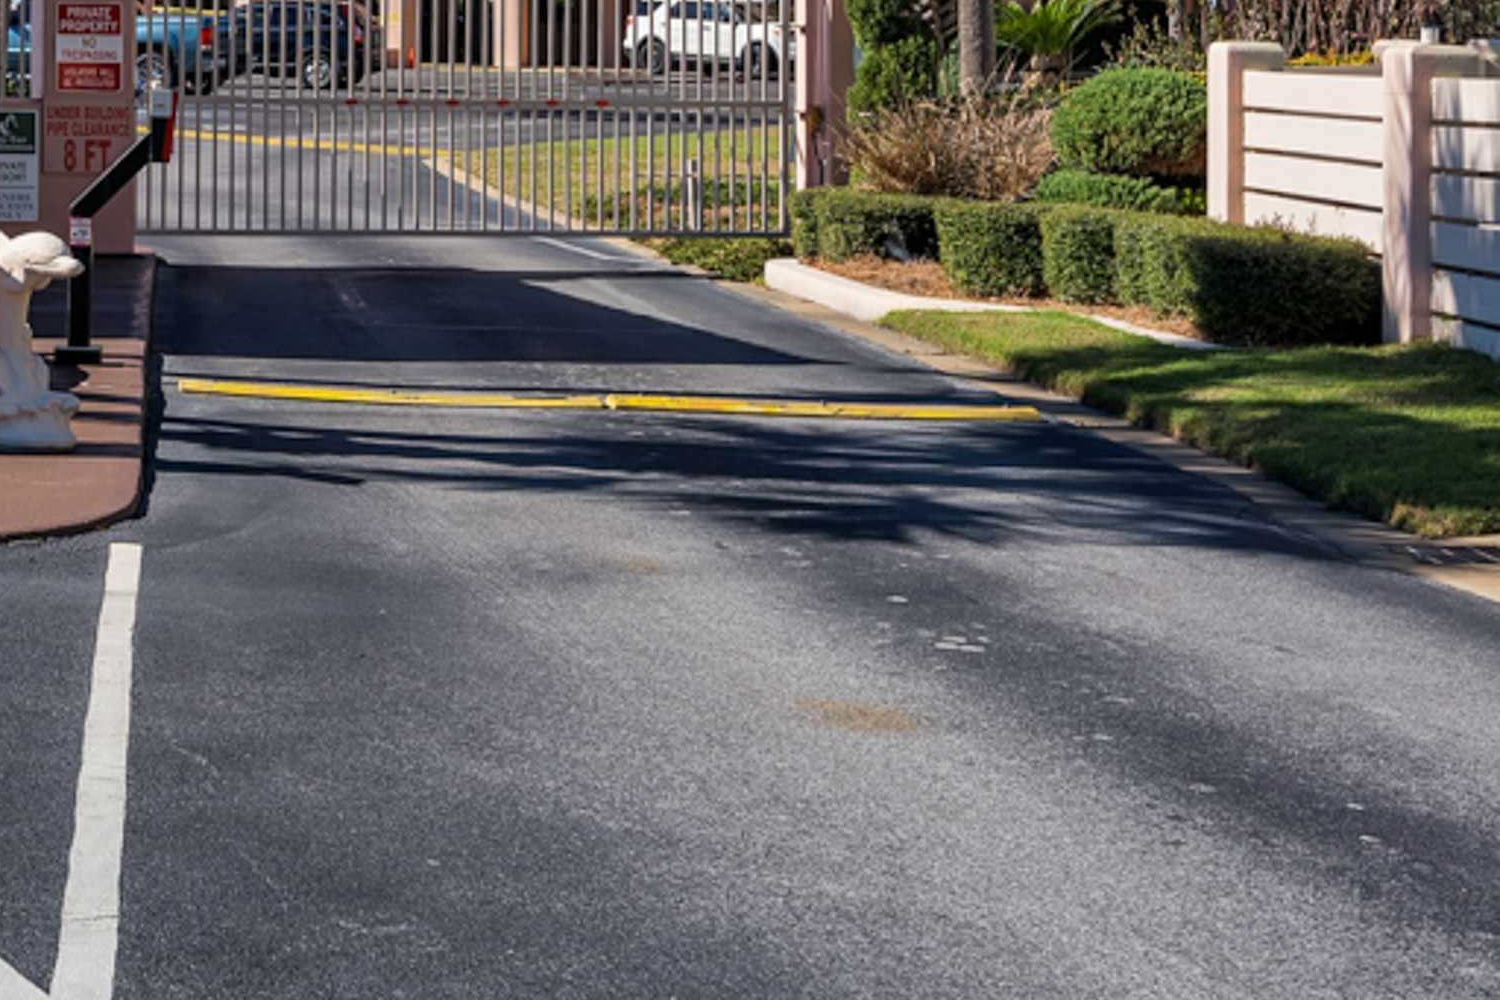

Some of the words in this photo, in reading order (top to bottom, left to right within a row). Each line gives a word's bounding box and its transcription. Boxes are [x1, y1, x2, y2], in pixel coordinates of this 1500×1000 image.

[66, 6, 112, 20] PRIVATE
[60, 20, 118, 32] PROPERTY
[82, 36, 97, 49] NO
[61, 49, 117, 60] TRESPASSING
[47, 105, 80, 119] UNDER
[84, 105, 131, 119] BUILDING
[47, 121, 68, 136] PIPE
[71, 121, 131, 136] CLEARANCE
[63, 139, 77, 172] 8
[84, 139, 112, 172] FT
